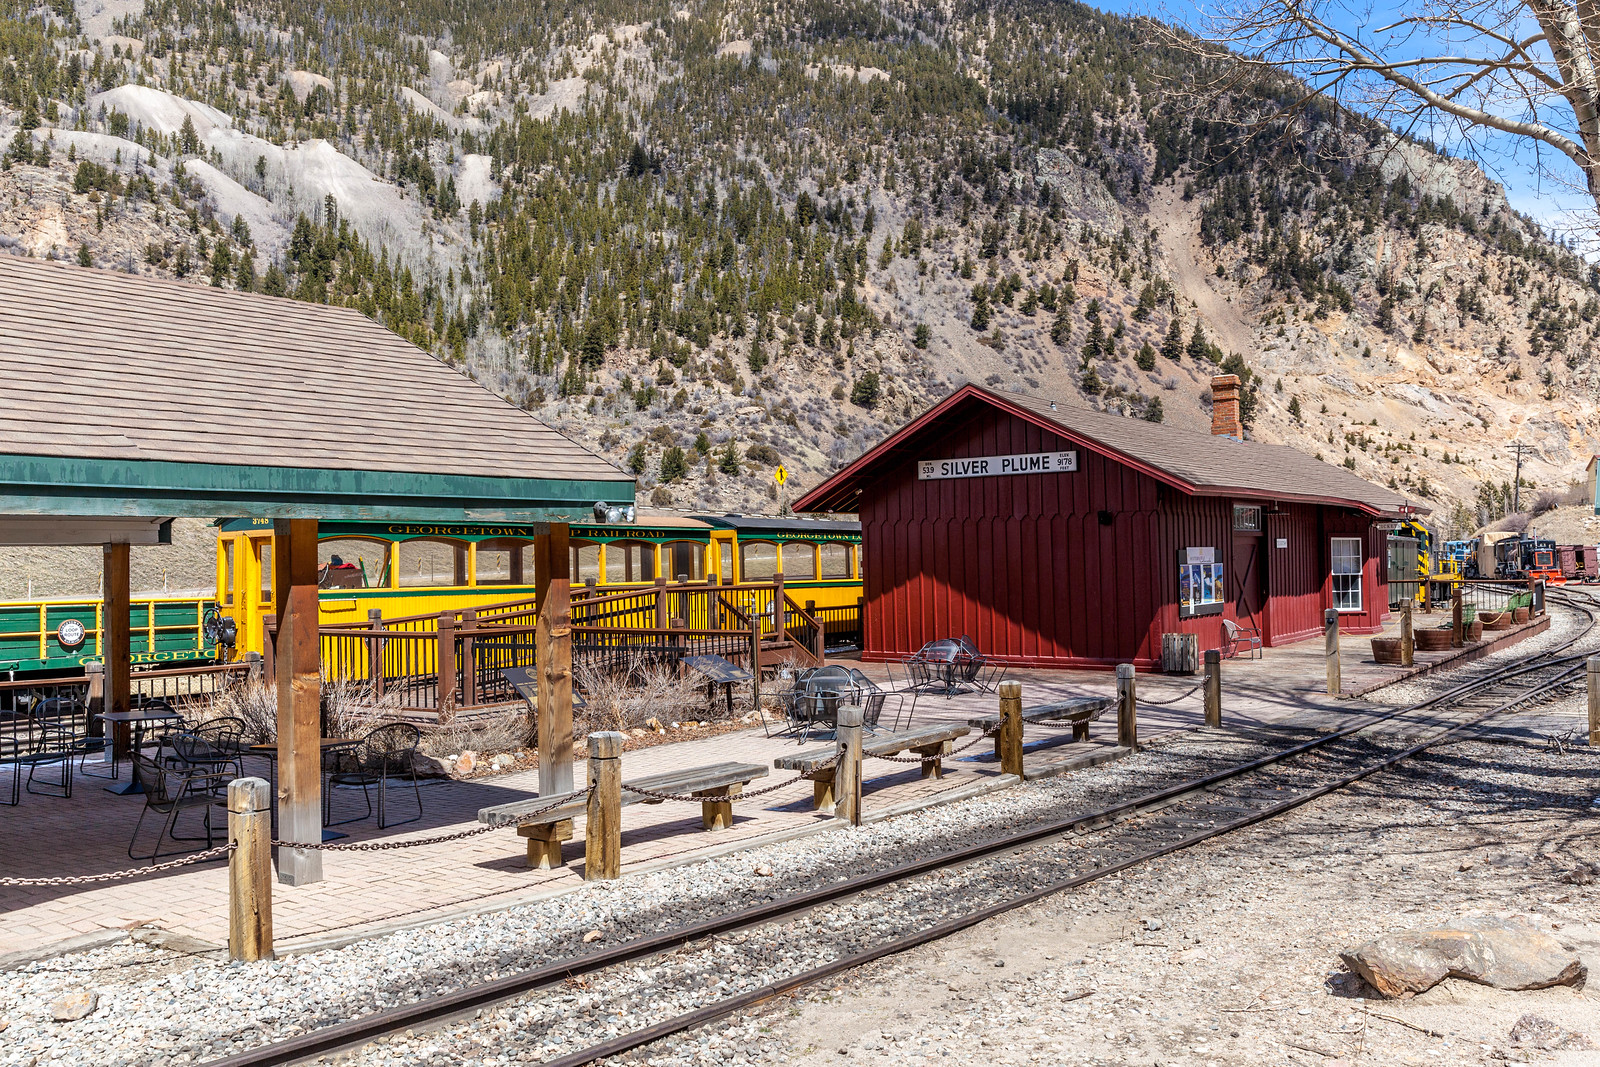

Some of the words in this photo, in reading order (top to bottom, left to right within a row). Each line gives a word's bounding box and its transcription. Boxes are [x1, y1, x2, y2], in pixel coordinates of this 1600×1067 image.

[941, 460, 989, 475] SILVER
[1002, 456, 1050, 472] PLUME
[1057, 457, 1073, 465] 9178
[388, 525, 528, 536] GEORGETOWN
[588, 529, 665, 538] RAILROAD
[776, 531, 849, 540] GEORGETOWN
